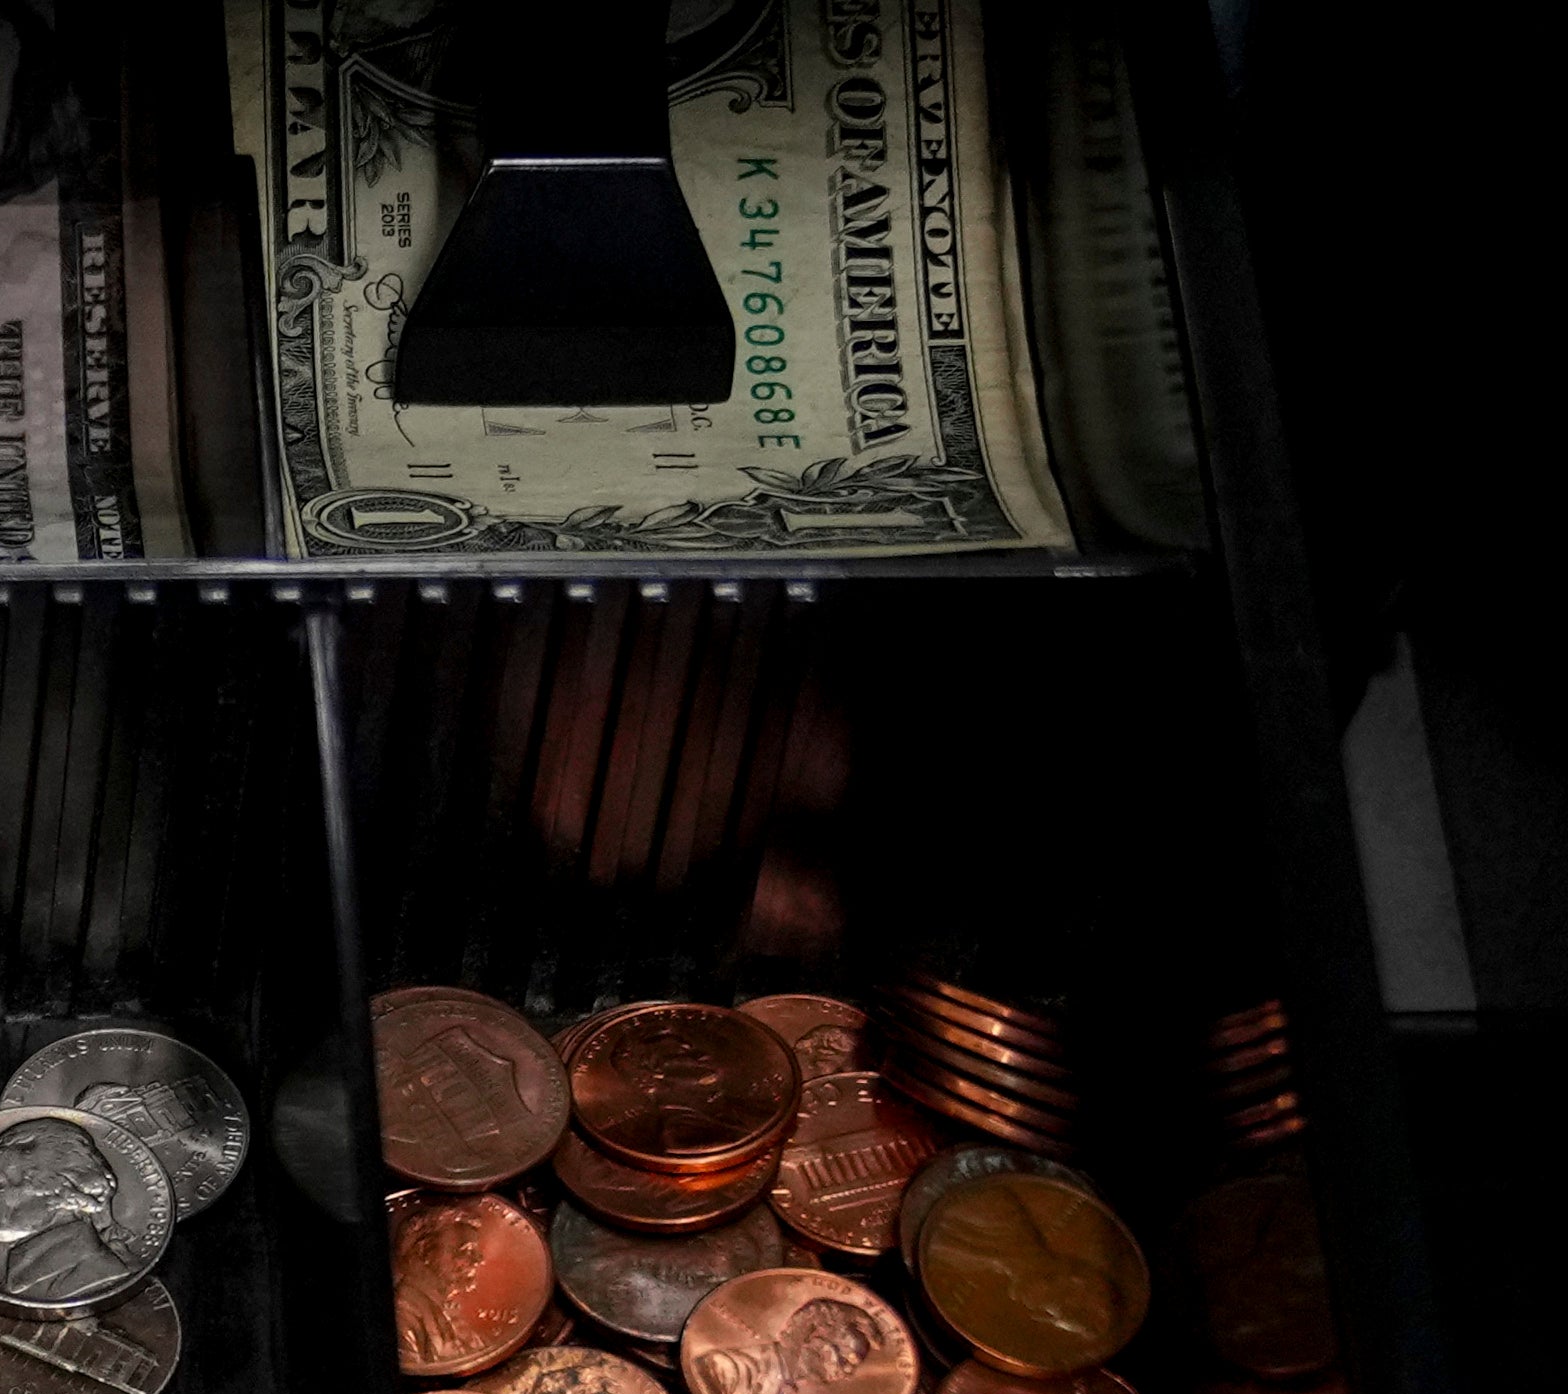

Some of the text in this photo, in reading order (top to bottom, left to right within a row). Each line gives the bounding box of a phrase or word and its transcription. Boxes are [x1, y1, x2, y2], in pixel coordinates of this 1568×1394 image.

[823, 76, 893, 170] OF
[912, 6, 961, 333] ERVE NOTE
[380, 203, 394, 237] 2013
[395, 191, 411, 248] SERIES
[340, 300, 357, 357] Secretary
[736, 156, 800, 451] K 34760868E
[826, 171, 911, 457] AMERICA
[345, 359, 357, 372] of
[345, 372, 358, 391] the
[79, 231, 125, 560] RESERVE NOTE
[347, 505, 444, 531] 1
[775, 506, 925, 538] 1
[102, 1127, 165, 1196] LIBERTY
